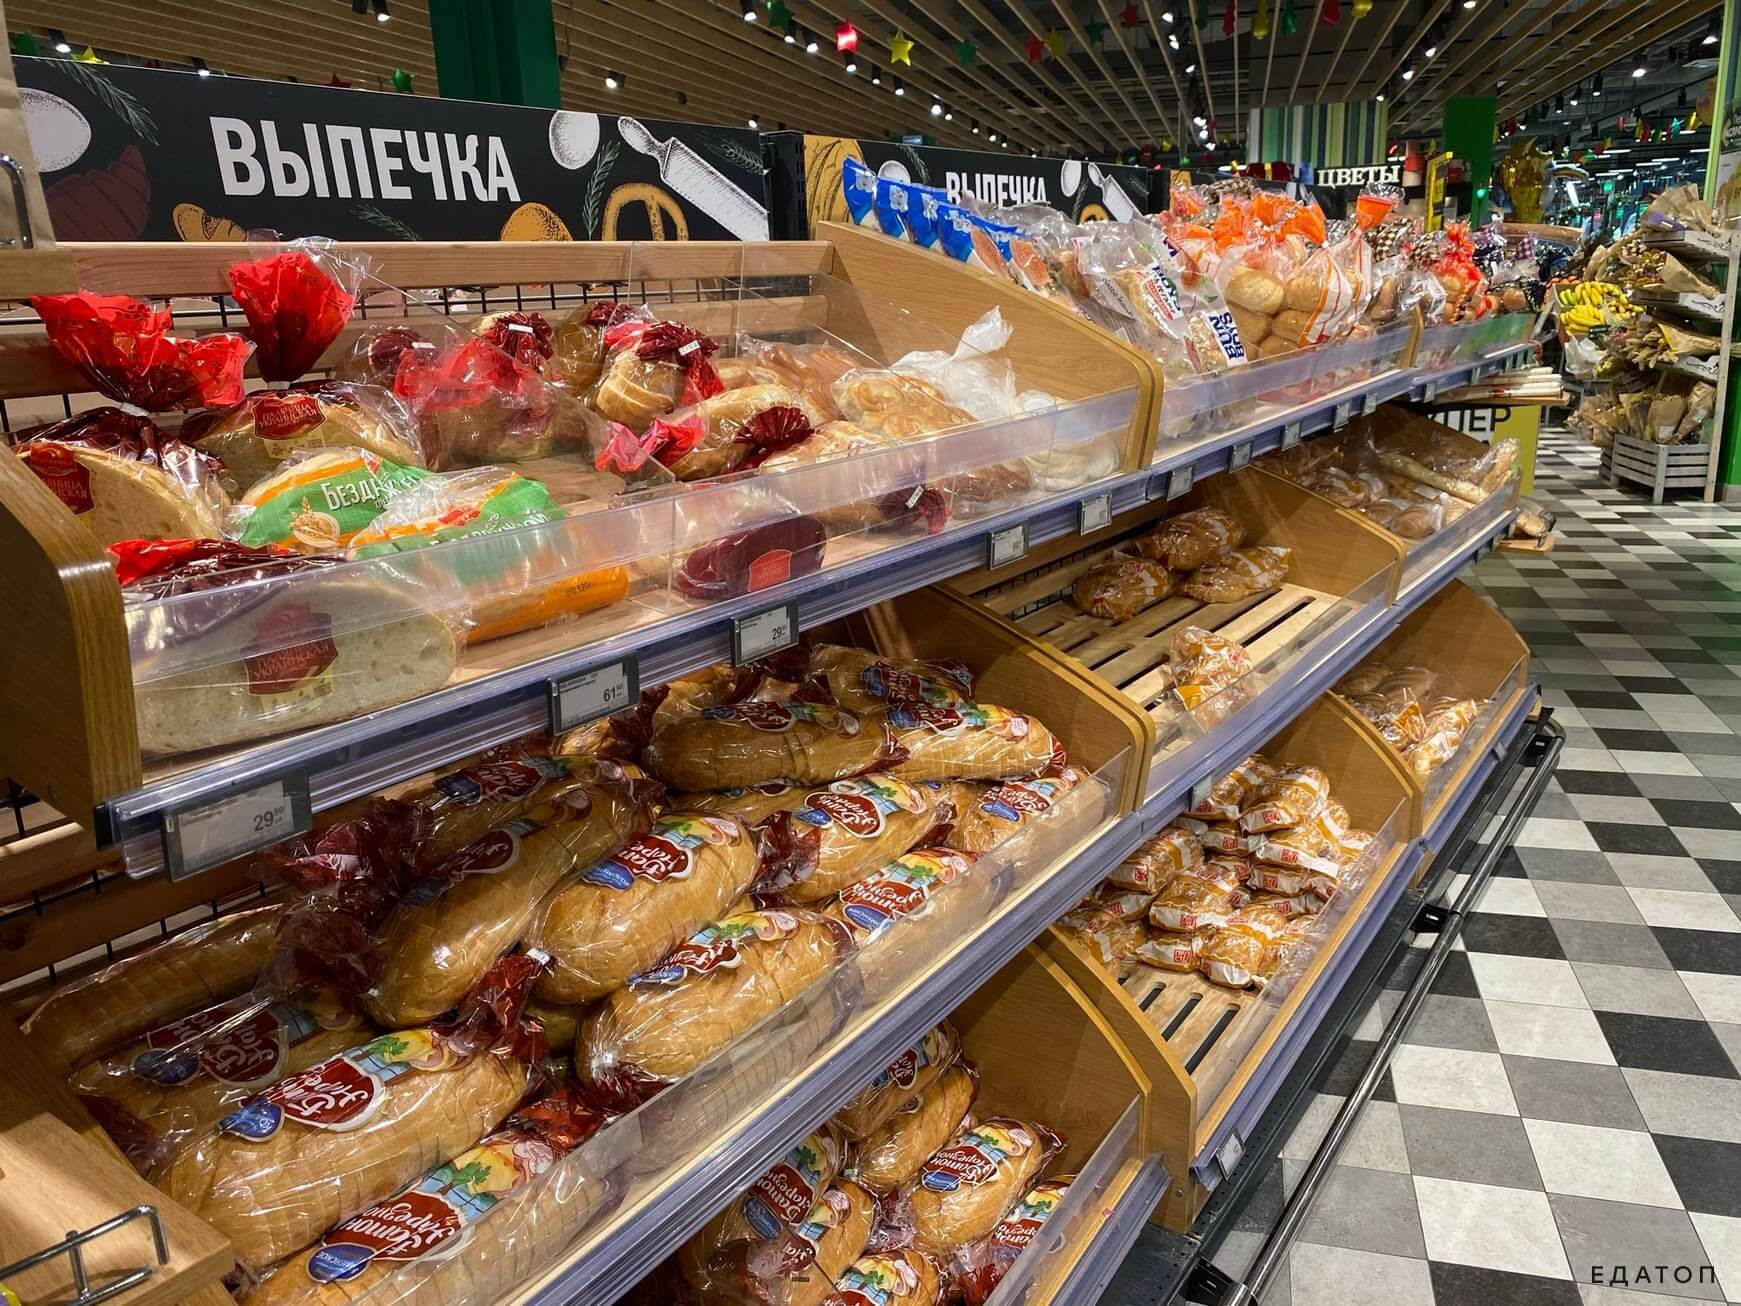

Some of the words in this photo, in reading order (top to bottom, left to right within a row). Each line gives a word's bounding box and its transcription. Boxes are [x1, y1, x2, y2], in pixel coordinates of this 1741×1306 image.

[210, 115, 522, 202] ВЫПЕЧКА
[1317, 165, 1401, 189] ЦВЕТЫ
[1208, 315, 1237, 360] BUN
[253, 810, 274, 832] 29
[930, 1157, 981, 1180] Батон
[340, 1216, 422, 1256] Батон
[361, 1202, 456, 1245] Нарезно
